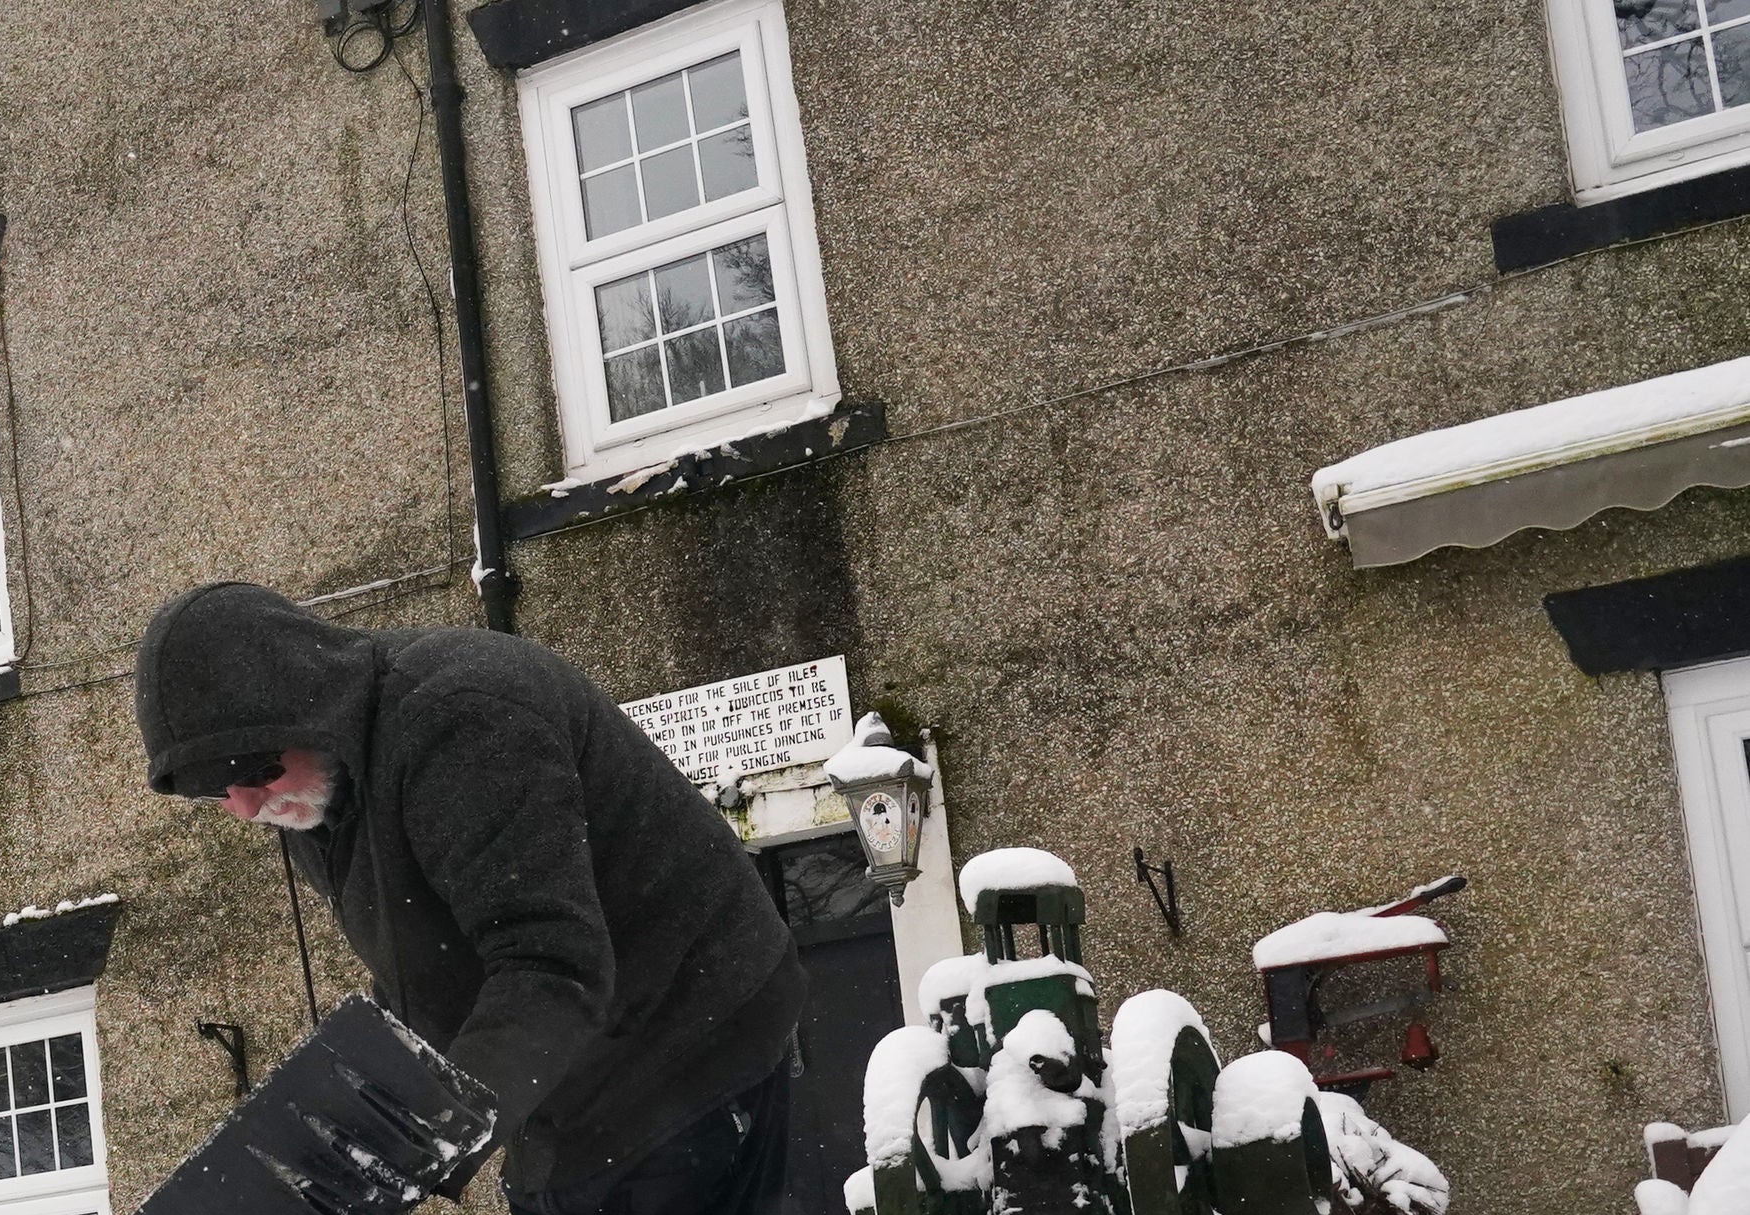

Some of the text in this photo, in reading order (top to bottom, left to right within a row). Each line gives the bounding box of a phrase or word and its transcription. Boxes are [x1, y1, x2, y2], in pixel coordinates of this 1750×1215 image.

[626, 698, 672, 718] ICENSED
[678, 692, 699, 706] FOR
[706, 686, 726, 700] THE
[732, 678, 760, 695] SALE
[767, 674, 781, 688] OF
[660, 705, 708, 726] SPIRITS
[728, 688, 784, 712] TOBACCOS
[788, 684, 805, 698] TO
[811, 679, 827, 693] BE
[681, 724, 696, 737] ON
[702, 719, 716, 732] OR
[722, 713, 743, 728] OFF
[750, 707, 771, 721] THE
[778, 693, 835, 716] PREMISES
[684, 739, 697, 752] IN
[703, 722, 773, 748] PURSUANCES
[779, 718, 793, 731] OF
[801, 712, 822, 727] ACT
[829, 708, 843, 721] OF
[698, 749, 719, 764] FOR
[726, 739, 767, 758] PUBLIC
[686, 764, 720, 781] MUSIC
[741, 750, 791, 771] SINGING
